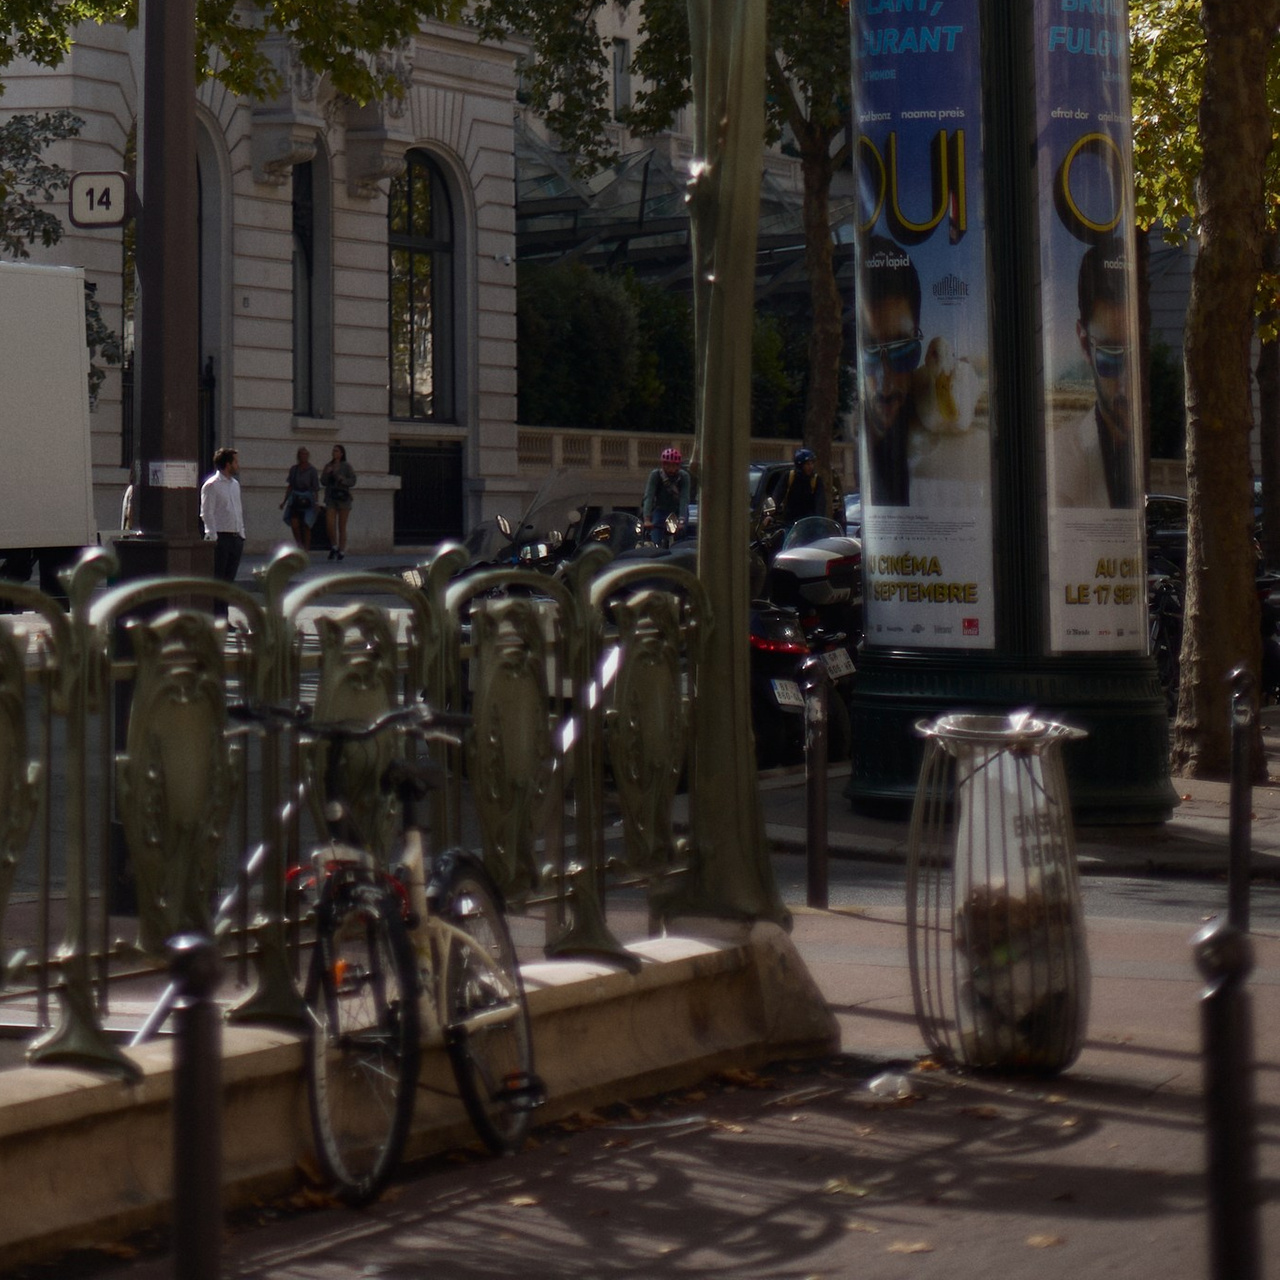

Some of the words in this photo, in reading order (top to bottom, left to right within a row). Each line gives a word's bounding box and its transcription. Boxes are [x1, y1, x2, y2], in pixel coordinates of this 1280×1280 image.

[901, 109, 936, 120] naama
[938, 107, 965, 122] preis
[1074, 108, 1090, 120] dor
[85, 186, 112, 211] 14
[885, 254, 910, 270] lapid
[878, 551, 942, 576] CINÉMA
[1095, 558, 1117, 578] AU
[874, 582, 979, 604] SEPTEMBRE
[1065, 584, 1091, 605] LE
[1093, 584, 1112, 605] 17
